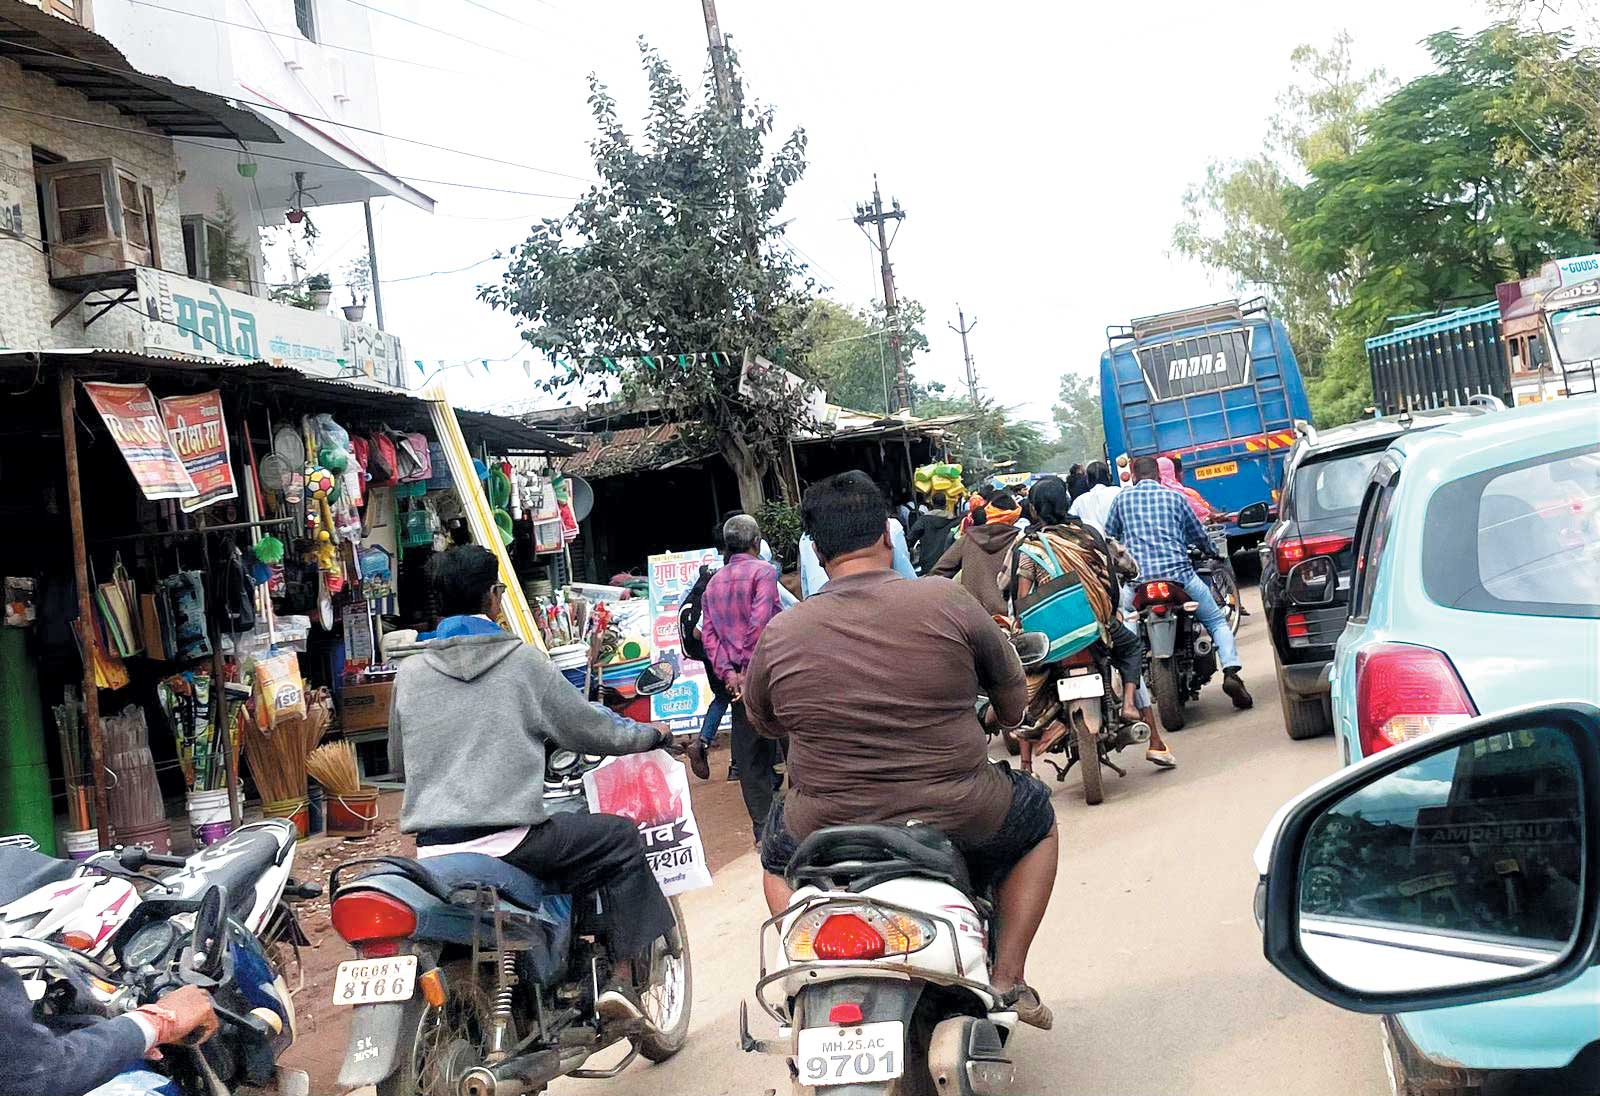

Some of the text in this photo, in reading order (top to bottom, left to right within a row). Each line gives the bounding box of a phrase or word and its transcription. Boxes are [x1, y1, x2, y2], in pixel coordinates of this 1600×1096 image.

[172, 287, 261, 360] मनोज
[822, 1038, 885, 1053] MH.25.AC
[806, 1050, 895, 1080] 9701
